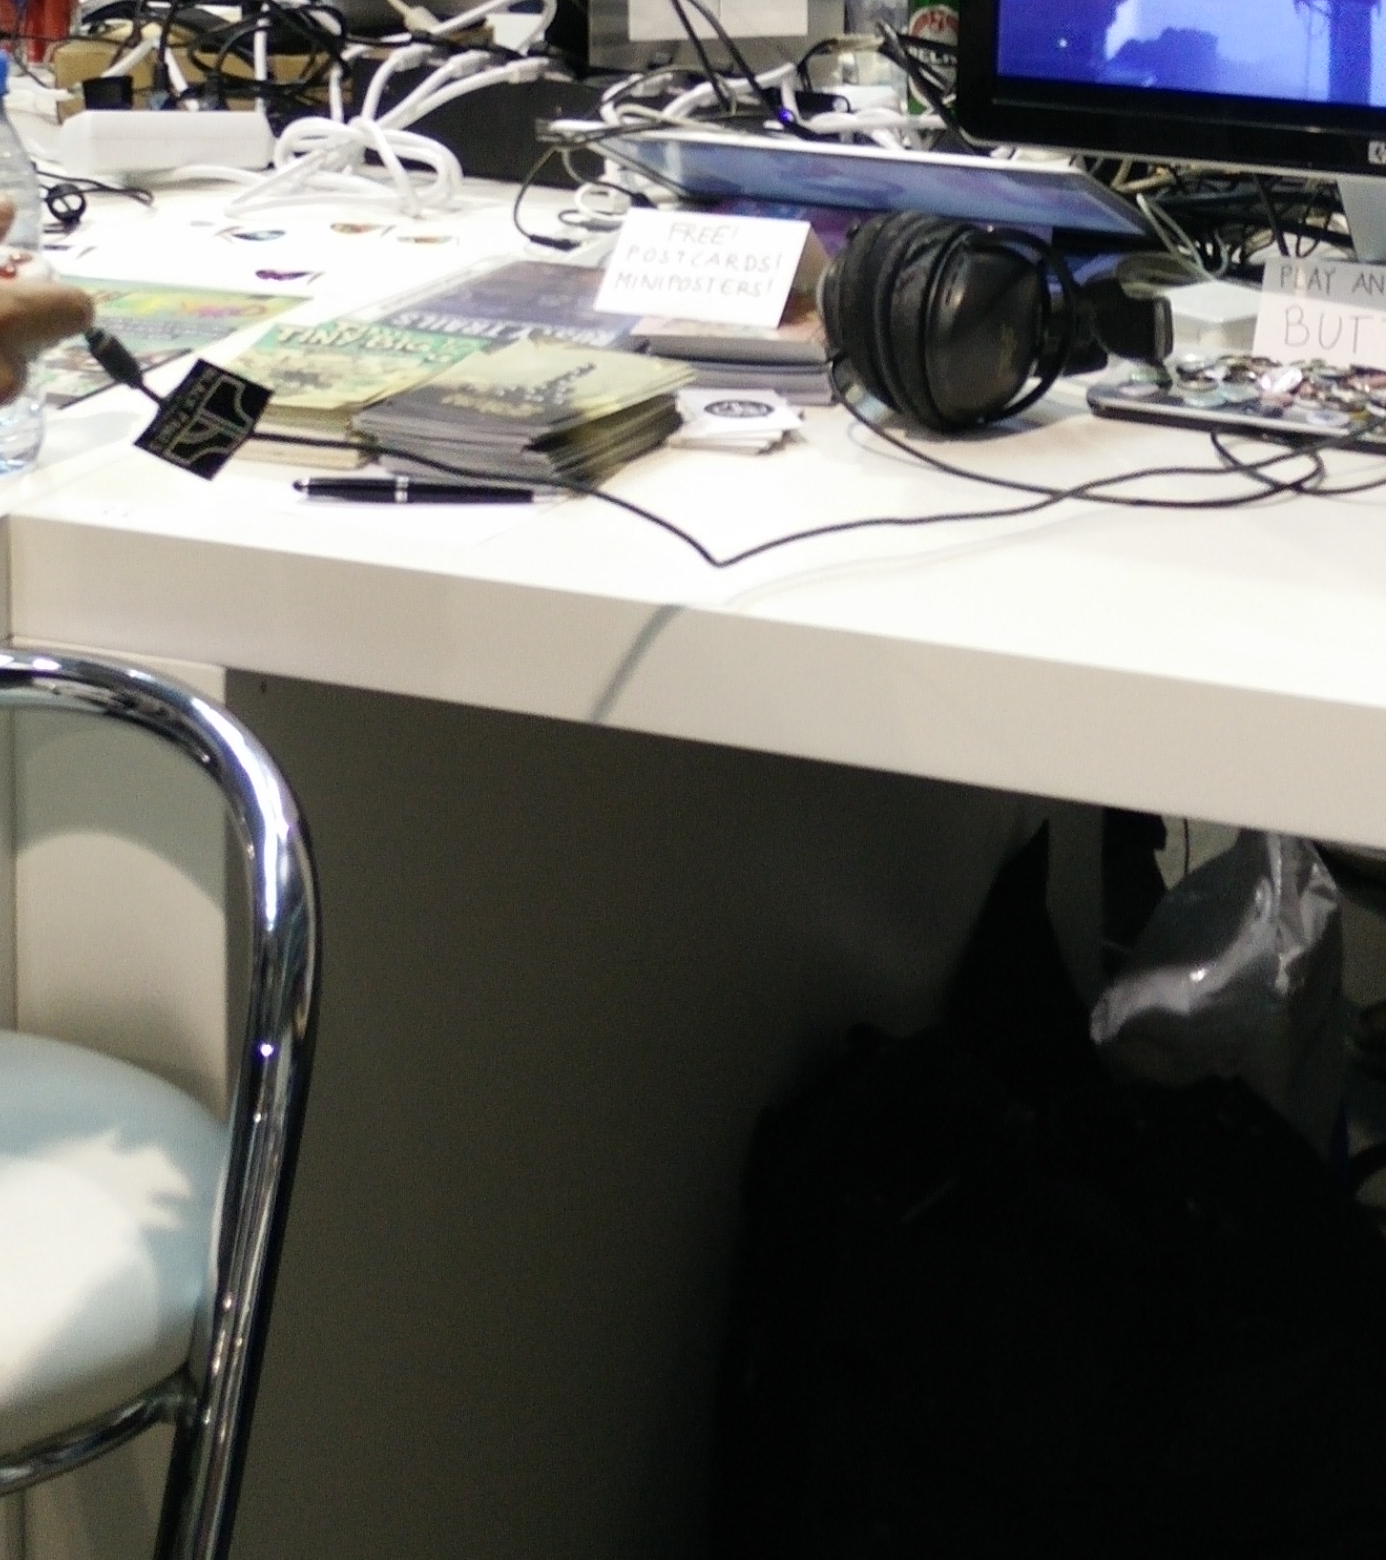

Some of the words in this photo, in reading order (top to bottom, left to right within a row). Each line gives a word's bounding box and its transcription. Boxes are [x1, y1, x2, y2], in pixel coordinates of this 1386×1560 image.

[667, 221, 740, 246] FREE!
[626, 244, 783, 274] POSTCARDS!
[614, 271, 773, 298] MINIPOSTERS!
